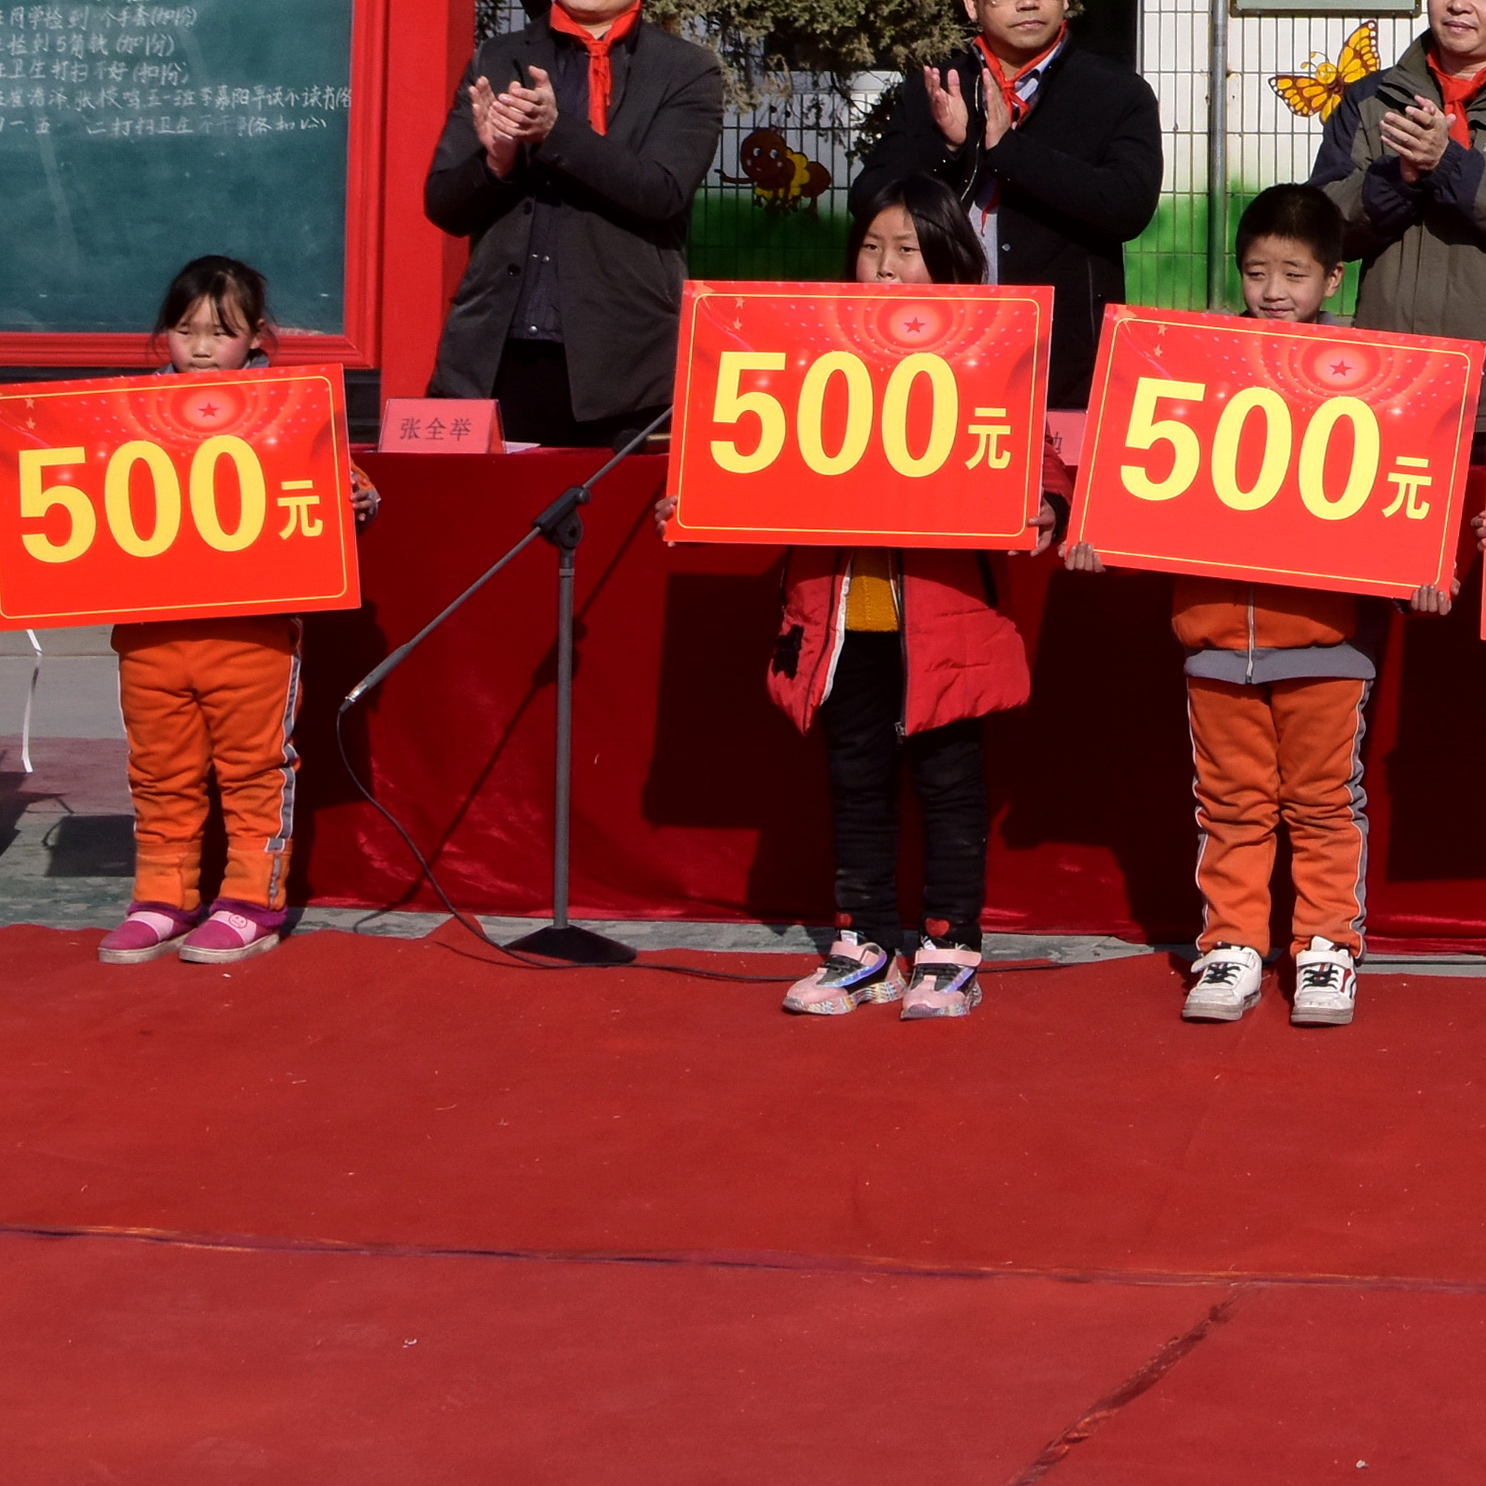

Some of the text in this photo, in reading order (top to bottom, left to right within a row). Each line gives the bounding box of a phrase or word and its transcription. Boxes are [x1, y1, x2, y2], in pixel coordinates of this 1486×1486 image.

[400, 417, 472, 441] 张全举
[711, 351, 1010, 477] 500元
[1120, 377, 1432, 520] 500元
[20, 435, 323, 563] 500元
